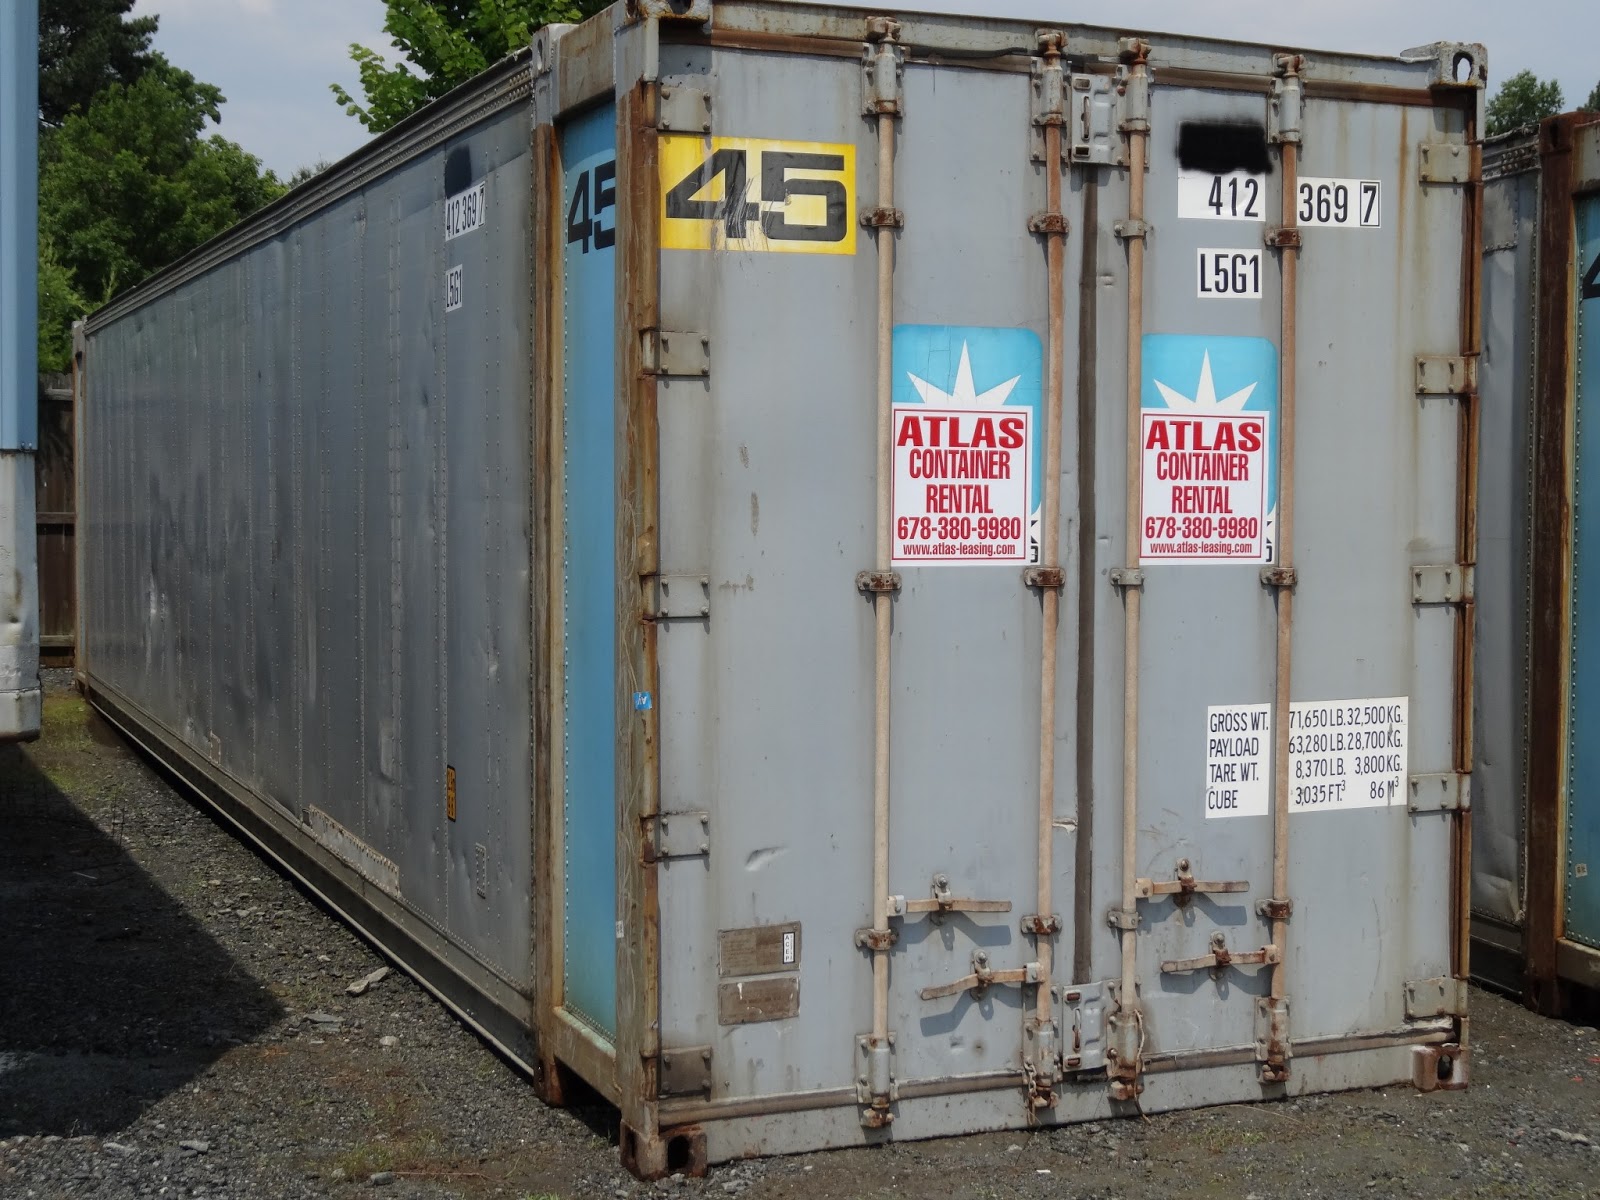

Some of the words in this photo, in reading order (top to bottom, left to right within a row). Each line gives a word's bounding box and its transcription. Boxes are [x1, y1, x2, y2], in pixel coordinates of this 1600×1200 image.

[567, 159, 616, 254] 45
[666, 148, 847, 242] 45
[1208, 175, 1259, 218] 412
[1299, 182, 1348, 223] 369
[1362, 184, 1378, 224] 7
[446, 199, 460, 238] 412
[462, 191, 477, 231] 369
[1200, 253, 1259, 293] L5G1
[446, 269, 462, 308] L5G1
[897, 416, 1024, 448] ATLAS
[1146, 420, 1261, 452] ATLAS
[909, 449, 1010, 479] CONTAINER
[1157, 452, 1249, 481] CONTAINER
[926, 484, 993, 513] RENTAL
[1172, 486, 1233, 513] RENTAL
[897, 516, 1021, 540] 678-380-9980
[1145, 516, 1258, 539] 678-380-9980
[903, 542, 1016, 556] www.atlas-leasing.com
[1150, 541, 1252, 555] www.atlas-leasing.com
[1210, 712, 1248, 732] GROSS
[1251, 711, 1269, 731] WT.
[1289, 709, 1328, 730] 71,650
[1330, 708, 1346, 727] LB.
[1347, 706, 1386, 726] 32,500
[1387, 705, 1403, 723] KG.
[1209, 737, 1259, 757] PAYLOAD
[1288, 733, 1328, 755] 63,280
[1330, 733, 1346, 751] LB.
[1347, 730, 1386, 751] 28,700
[1387, 729, 1403, 748] KG.
[1209, 763, 1237, 782] TARE
[1240, 762, 1259, 781] WT.
[1295, 758, 1328, 779] 8,370
[1330, 757, 1346, 775] LB.
[1354, 755, 1385, 776] 3,800
[1387, 754, 1403, 772] KG.
[1208, 789, 1239, 809] CUBE
[1295, 785, 1326, 806] 3,035
[1370, 781, 1385, 799] 86
